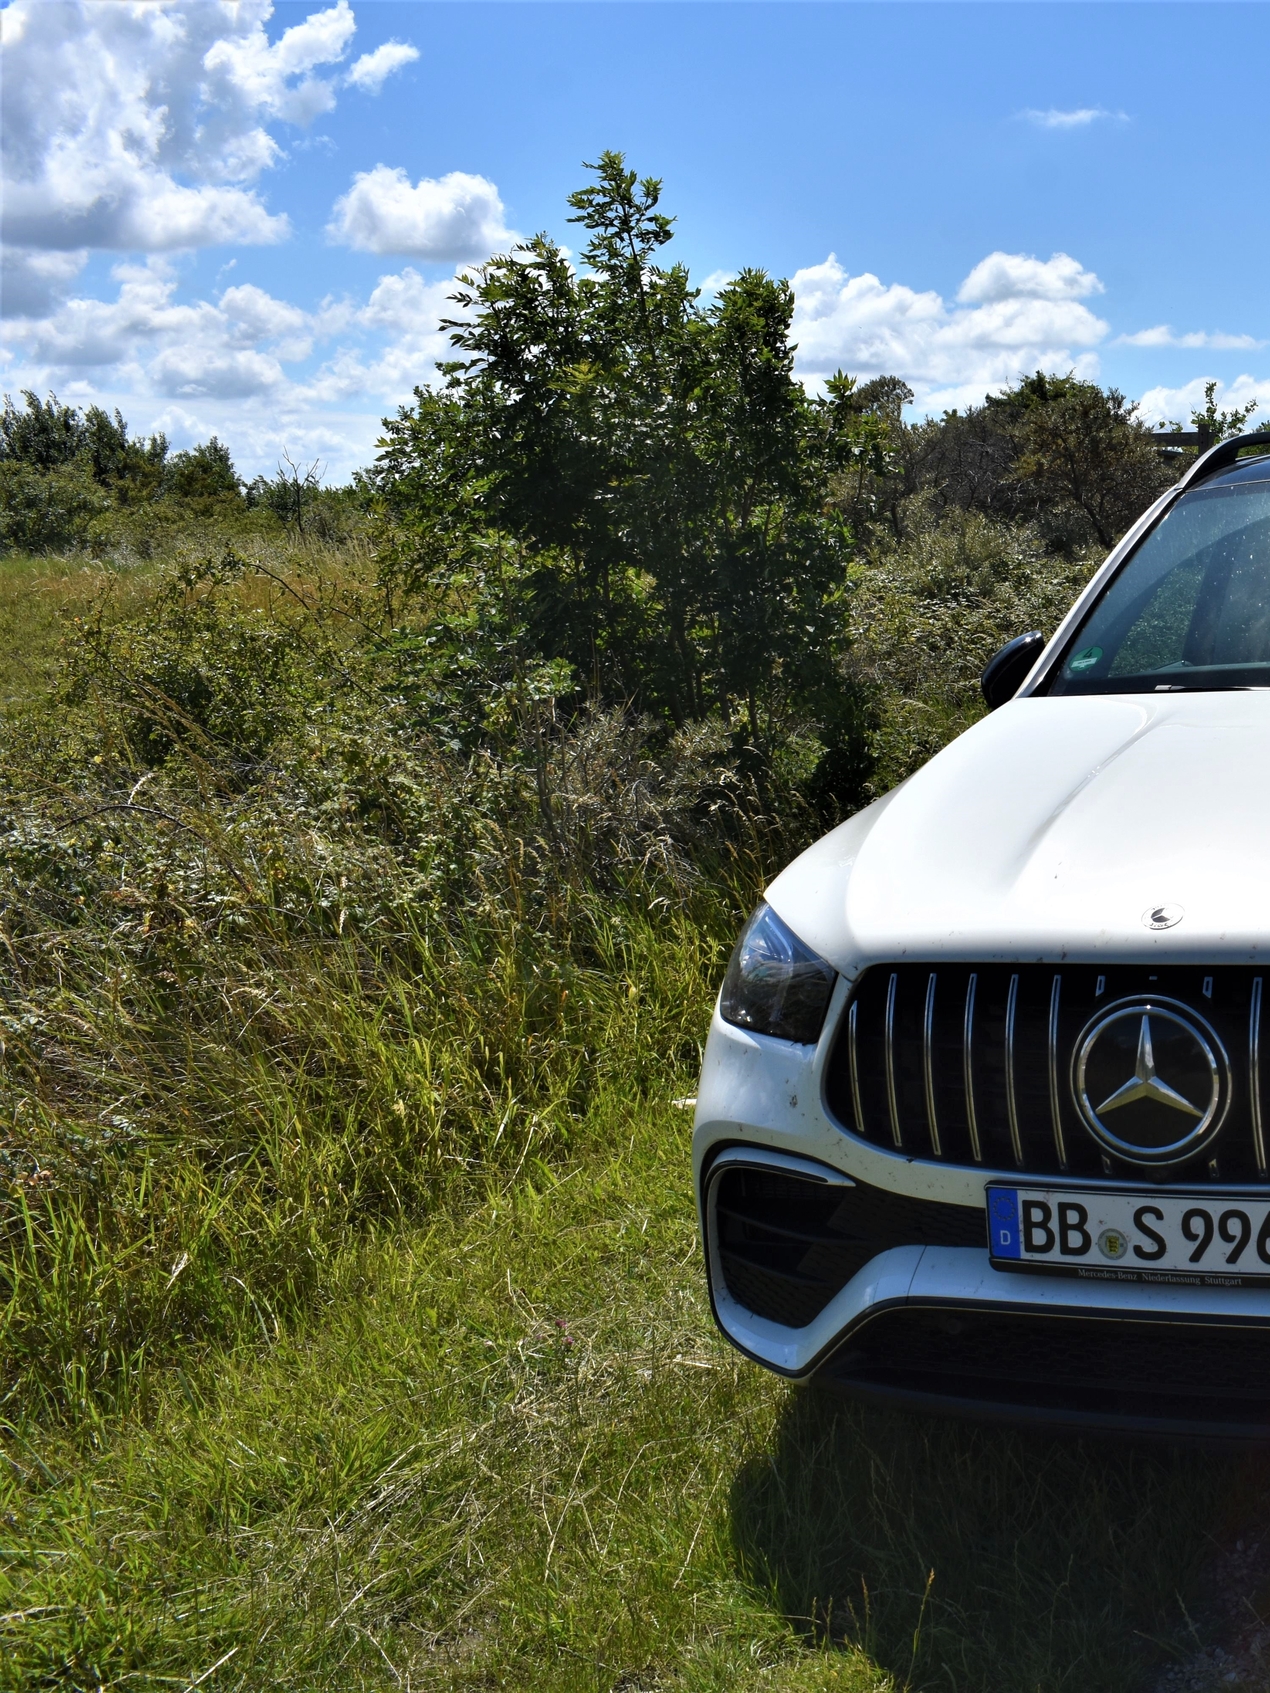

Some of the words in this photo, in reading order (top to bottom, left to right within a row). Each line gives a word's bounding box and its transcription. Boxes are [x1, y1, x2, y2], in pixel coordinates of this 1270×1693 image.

[1083, 648, 1093, 658] 4
[1001, 1230, 1011, 1246] D
[1022, 1200, 1092, 1256] BB
[1133, 1206, 1167, 1260] S
[1078, 1269, 1138, 1280] Mercedes-Benz
[1141, 1274, 1201, 1285] Niederlassung
[1204, 1276, 1242, 1286] Stuttgart
